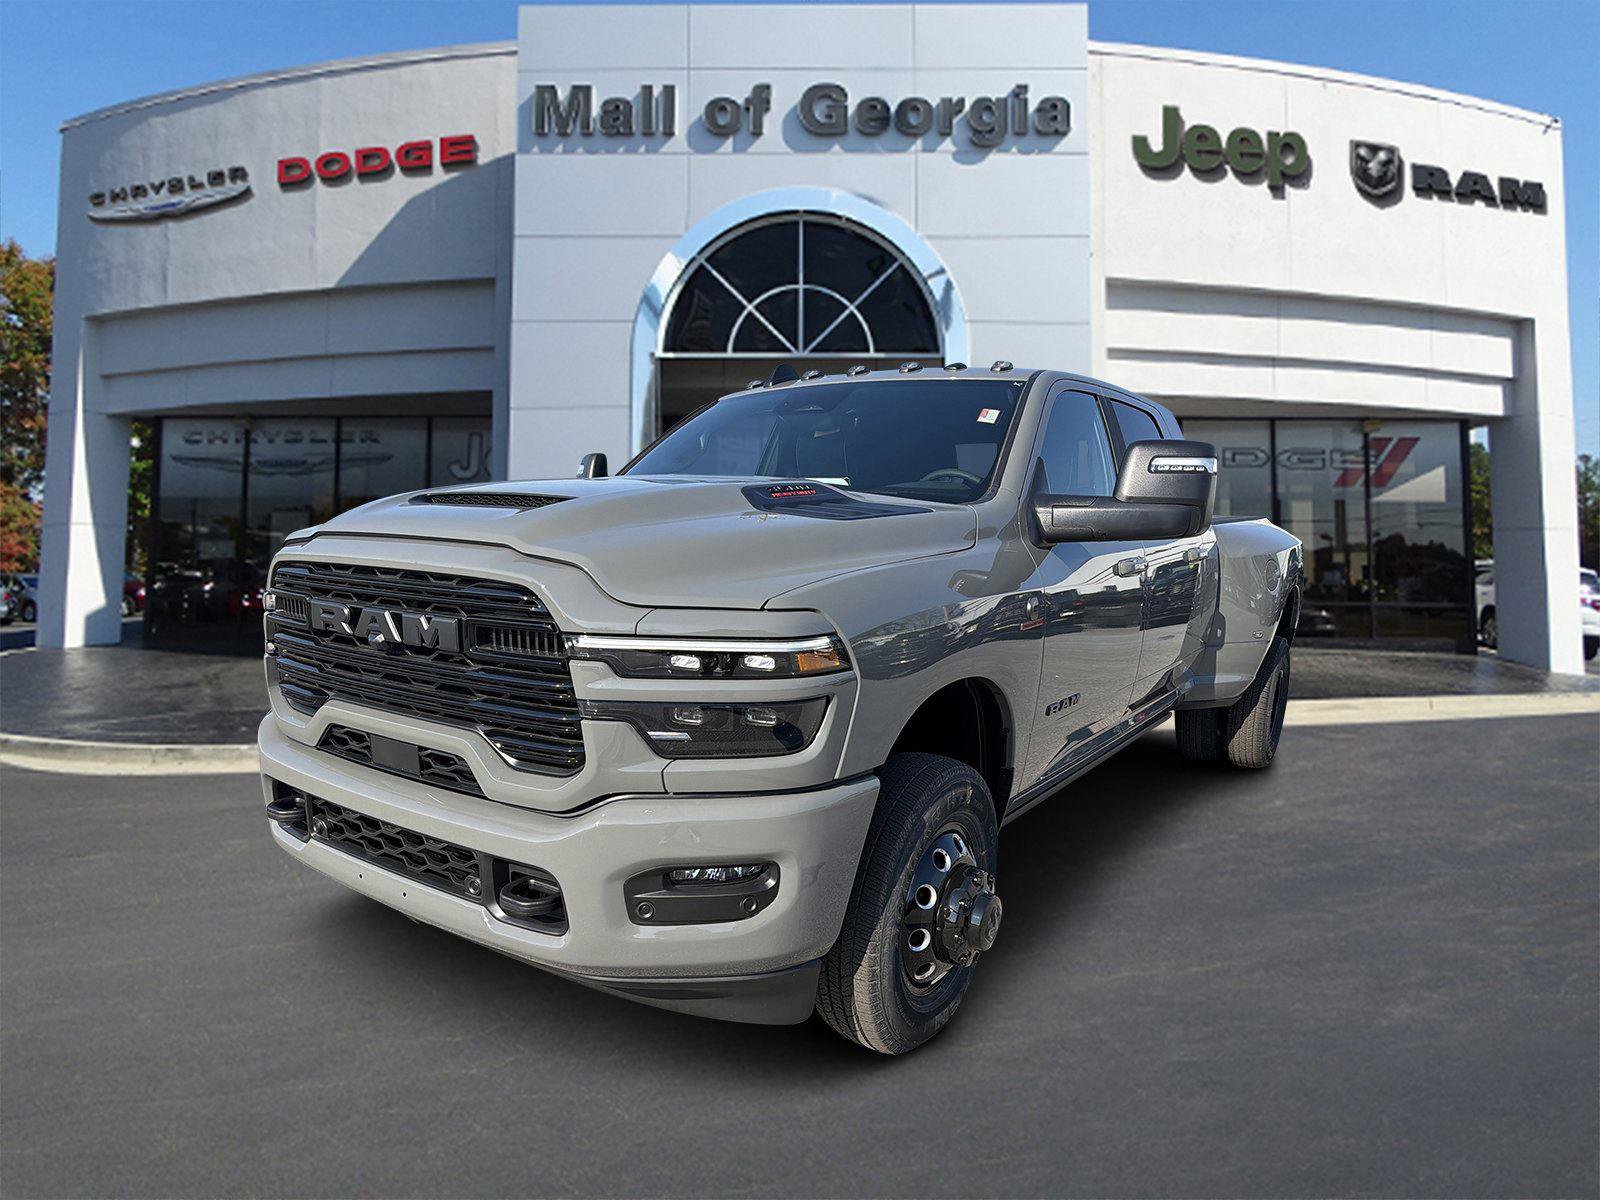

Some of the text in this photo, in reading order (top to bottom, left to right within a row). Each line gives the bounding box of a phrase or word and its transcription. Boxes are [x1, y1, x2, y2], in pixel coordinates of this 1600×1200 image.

[533, 83, 1072, 147] Mall of Georgia
[277, 134, 478, 188] DODGE
[1132, 105, 1310, 191] Jeep
[89, 166, 249, 207] CHRYSLER
[1411, 163, 1547, 214] RAM
[183, 429, 381, 444] CHRYSLER
[311, 600, 460, 652] RAM
[1045, 692, 1081, 717] RAM
